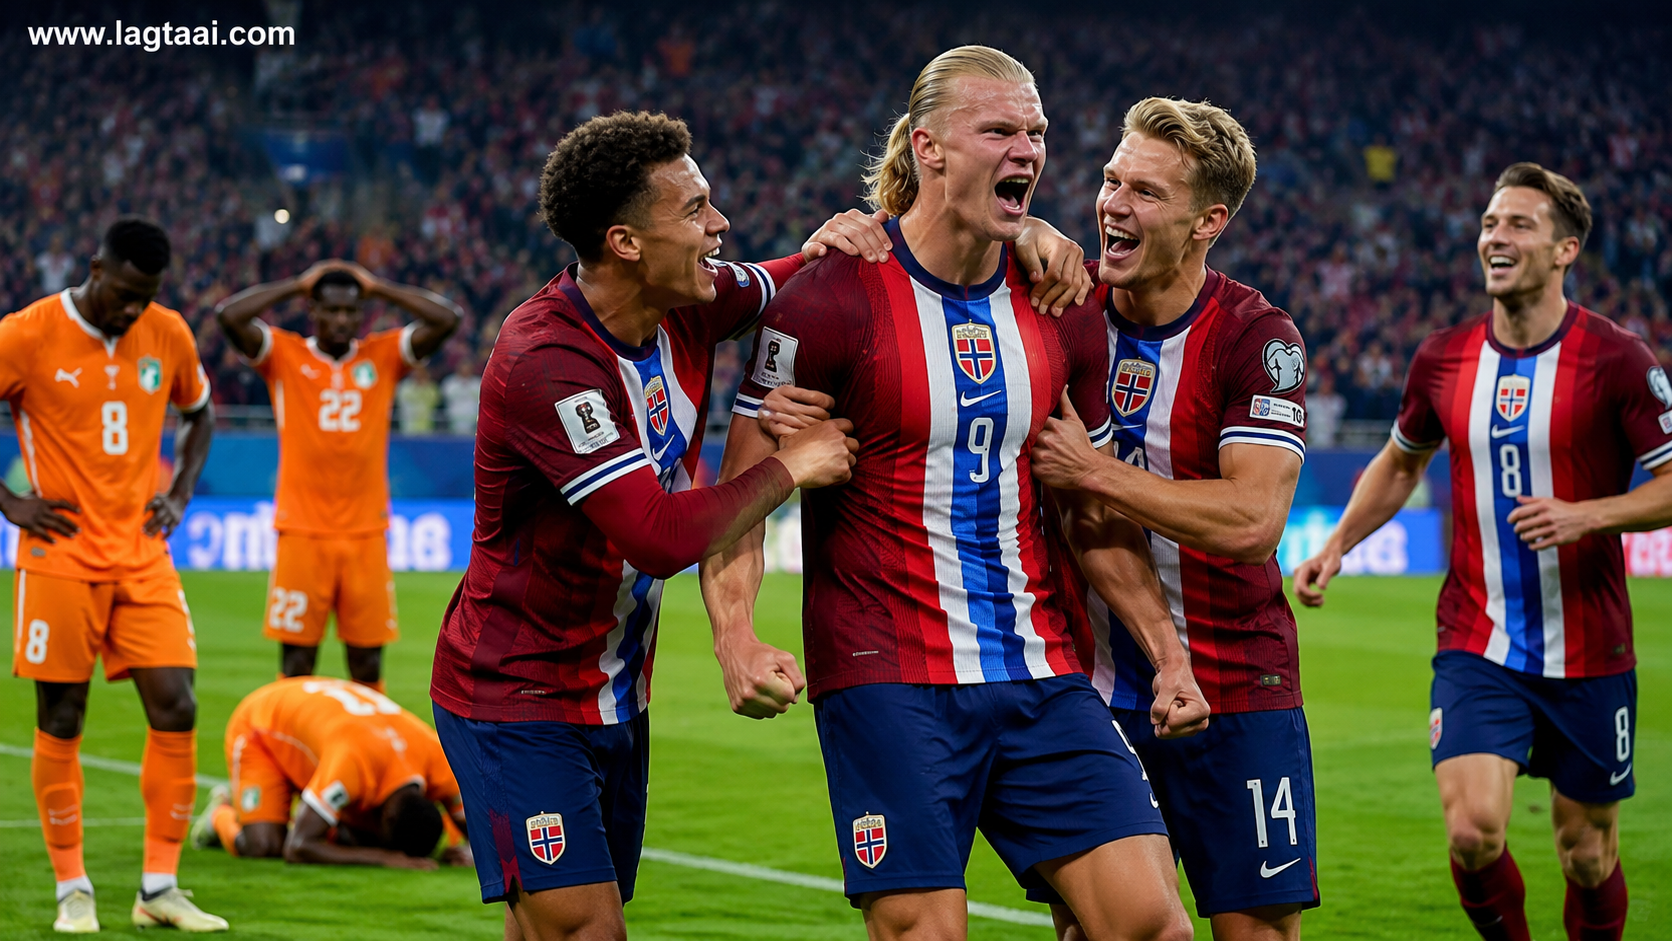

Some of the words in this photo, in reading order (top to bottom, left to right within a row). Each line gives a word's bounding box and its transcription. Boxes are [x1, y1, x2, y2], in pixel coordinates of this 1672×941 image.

[101, 401, 129, 455] 8
[318, 389, 362, 432] 22
[967, 417, 994, 483] 9
[1500, 444, 1522, 498] 8
[268, 588, 308, 632] 22
[25, 619, 50, 664] 8
[1614, 706, 1631, 762] 8
[1246, 777, 1297, 848] 14
